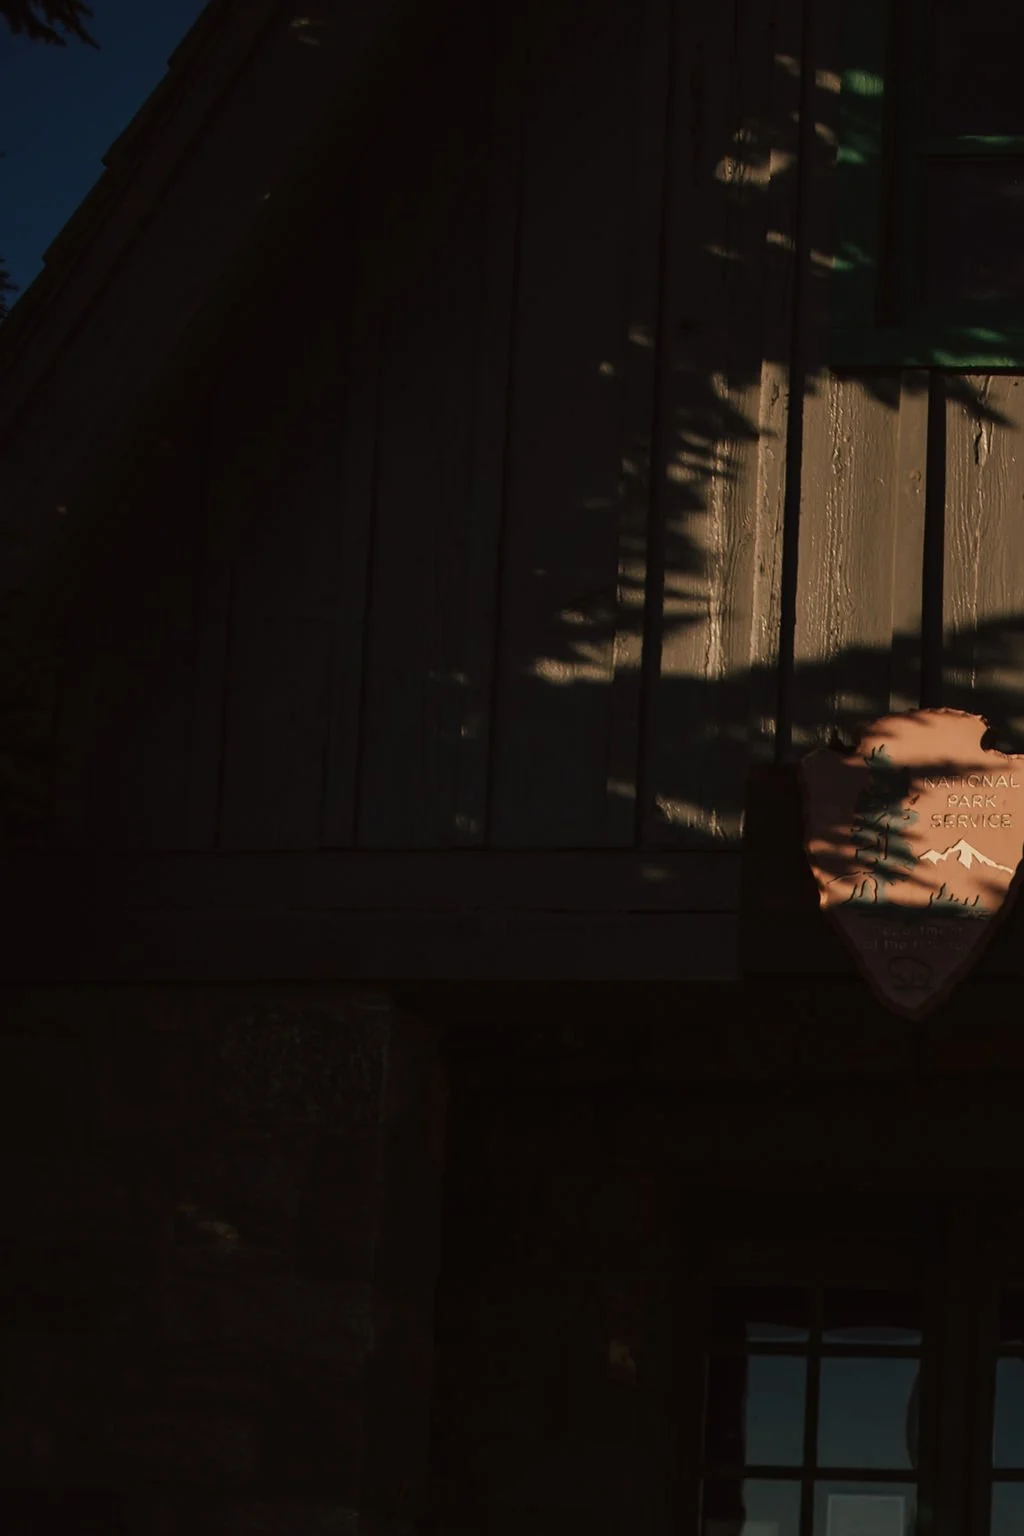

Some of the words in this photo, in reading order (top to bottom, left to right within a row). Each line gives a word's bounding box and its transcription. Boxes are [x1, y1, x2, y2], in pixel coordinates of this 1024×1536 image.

[923, 774, 1020, 788] NATIONAL
[947, 794, 997, 808] PARK
[931, 813, 1012, 828] SERVICE
